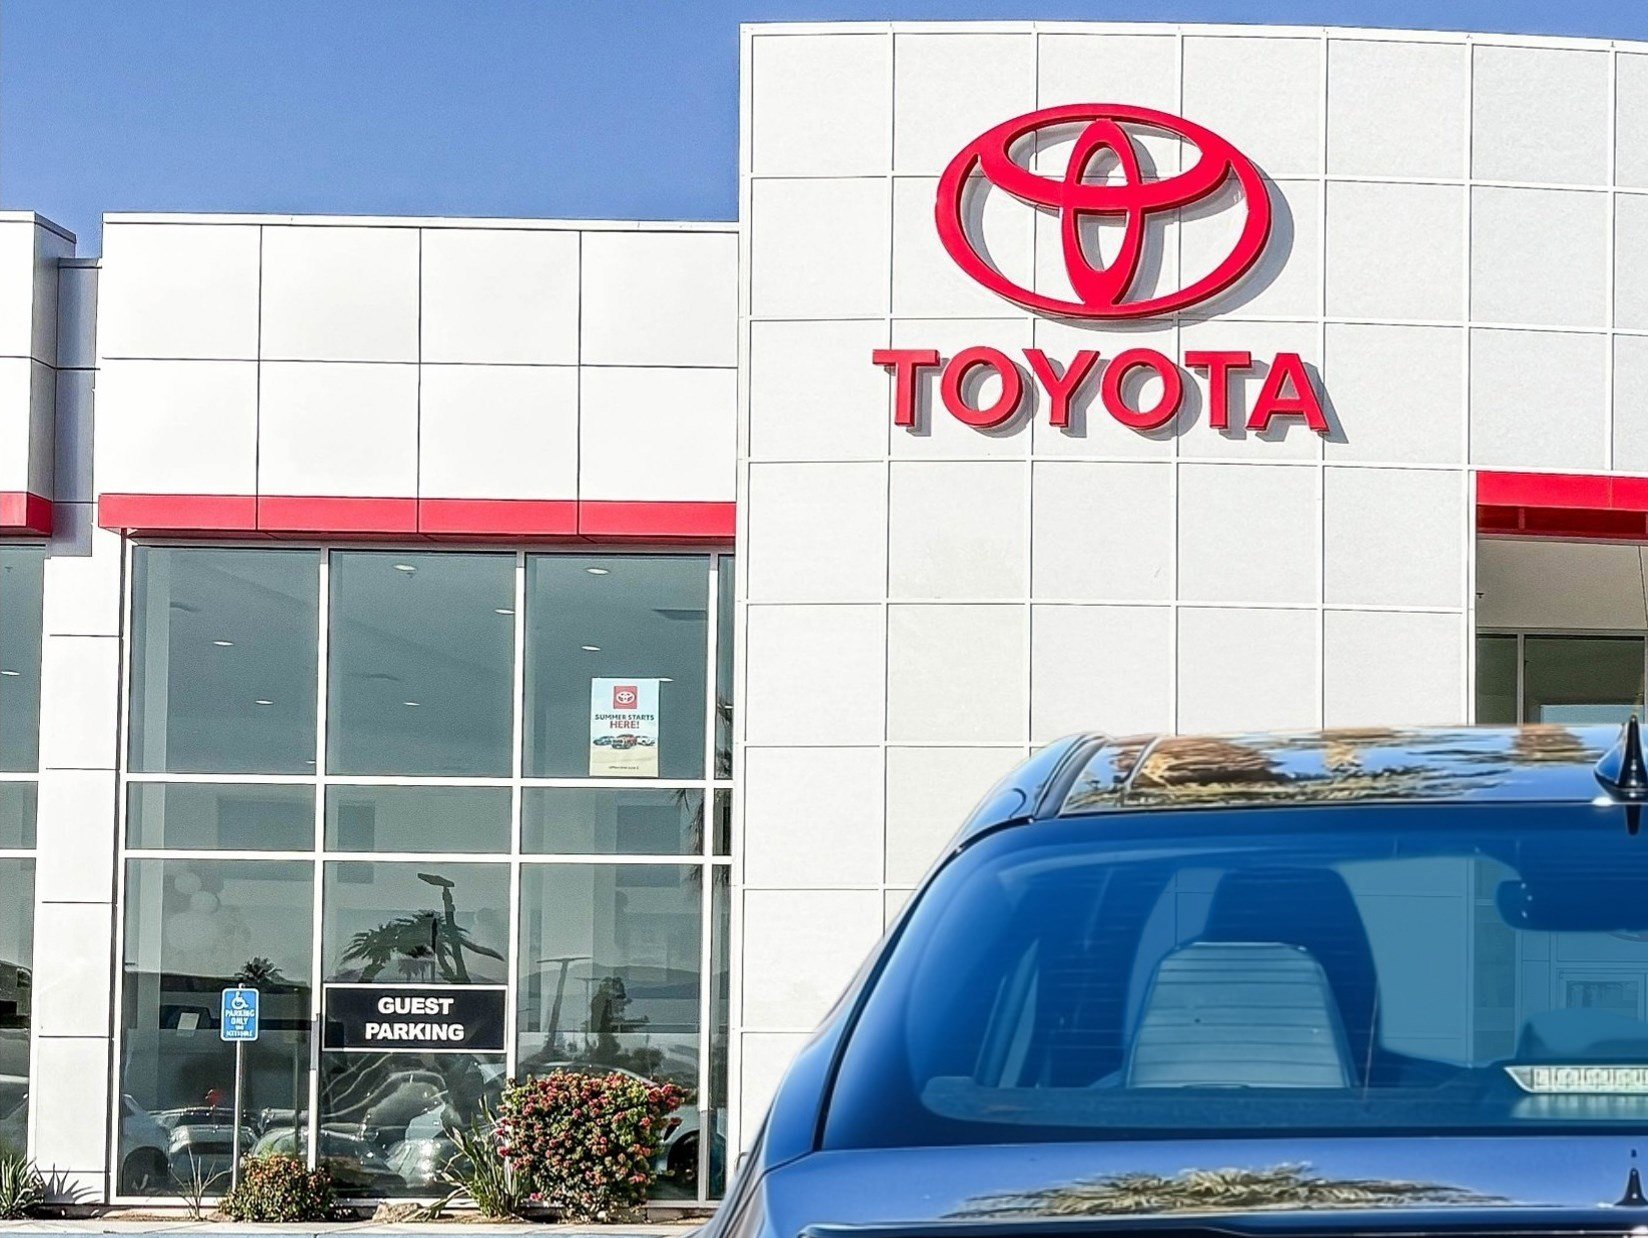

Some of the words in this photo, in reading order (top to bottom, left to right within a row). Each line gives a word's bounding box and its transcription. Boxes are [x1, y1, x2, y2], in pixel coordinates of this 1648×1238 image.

[872, 346, 1329, 433] TOYOTA
[609, 720, 640, 729] HERE!
[377, 997, 454, 1015] GUEST
[225, 1009, 255, 1018] PARKING
[230, 1017, 249, 1025] ONLY
[365, 1023, 465, 1041] PARKING
